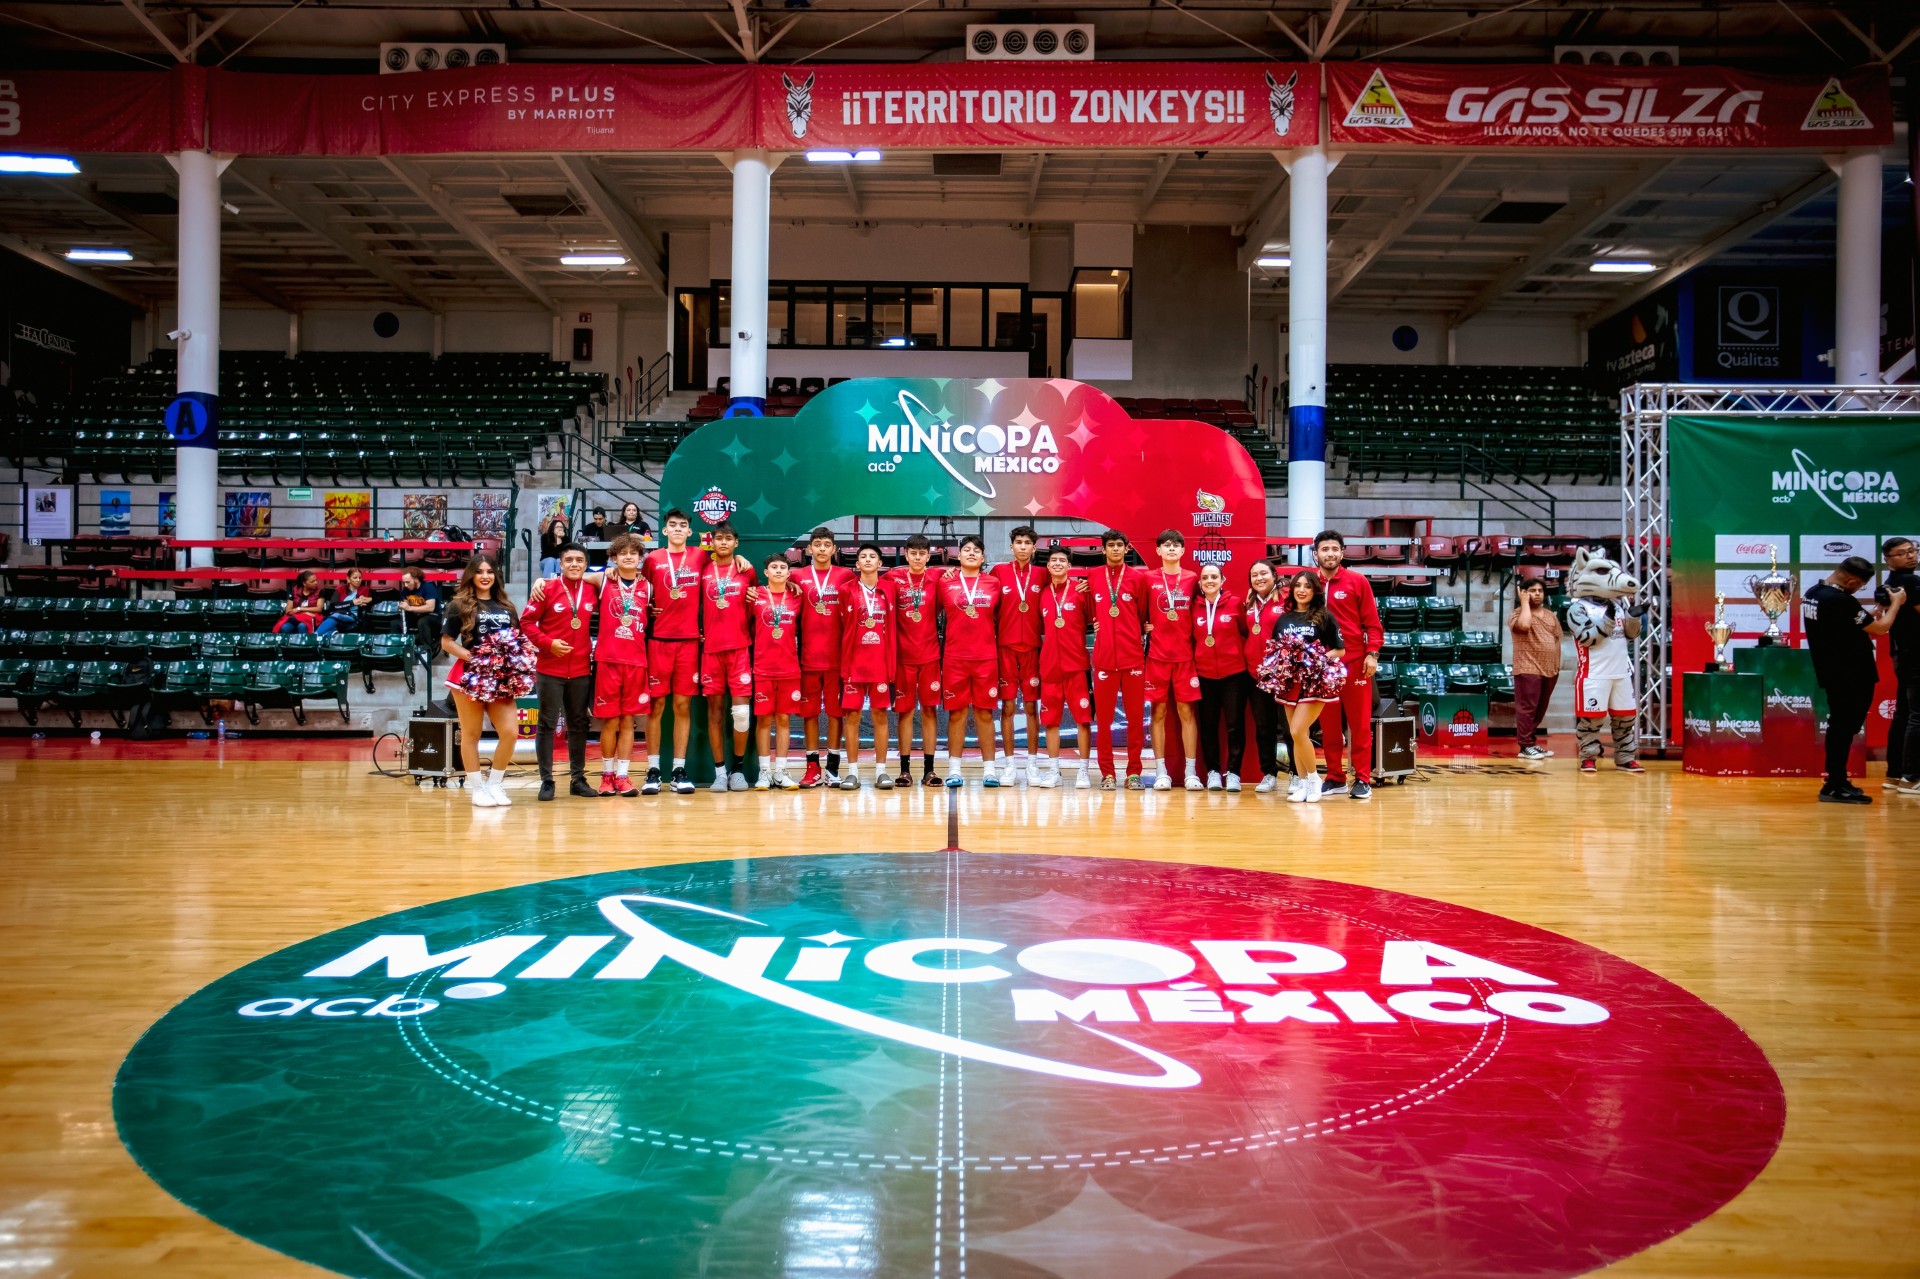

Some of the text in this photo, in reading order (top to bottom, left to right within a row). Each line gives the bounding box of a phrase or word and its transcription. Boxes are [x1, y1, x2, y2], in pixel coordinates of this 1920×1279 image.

[362, 86, 616, 112] CITY EXPRESS PLUS
[1445, 87, 1764, 124] GAS SILZA
[508, 108, 615, 120] BY MARRIOTT
[842, 90, 1245, 125] ¡¡TERRITORIO ZONKEYS!!
[1349, 116, 1405, 125] GAS SILZA
[1807, 119, 1866, 128] GAS SILZA
[586, 126, 615, 135] Tijuana
[1569, 127, 1589, 137] NO
[1593, 127, 1609, 137] TE
[1613, 127, 1665, 138] QUEDES
[1670, 127, 1692, 137] SIN
[1697, 127, 1729, 138] GAS!
[1606, 344, 1656, 372] tv azteca
[1717, 351, 1780, 369] Quálitas
[174, 401, 198, 435] A
[868, 452, 1060, 474] acb MÉXICO
[1772, 489, 1900, 504] acb MÉXICO
[693, 500, 737, 513] ZONKEYS
[1193, 512, 1232, 527] HALCONES
[1736, 543, 1767, 555] Coca-Cola
[1825, 544, 1851, 552] Rosarito
[1193, 550, 1232, 562] PIONEROS
[1448, 724, 1479, 733] PIONEROS
[237, 982, 1610, 1025] acb MÉXICO
